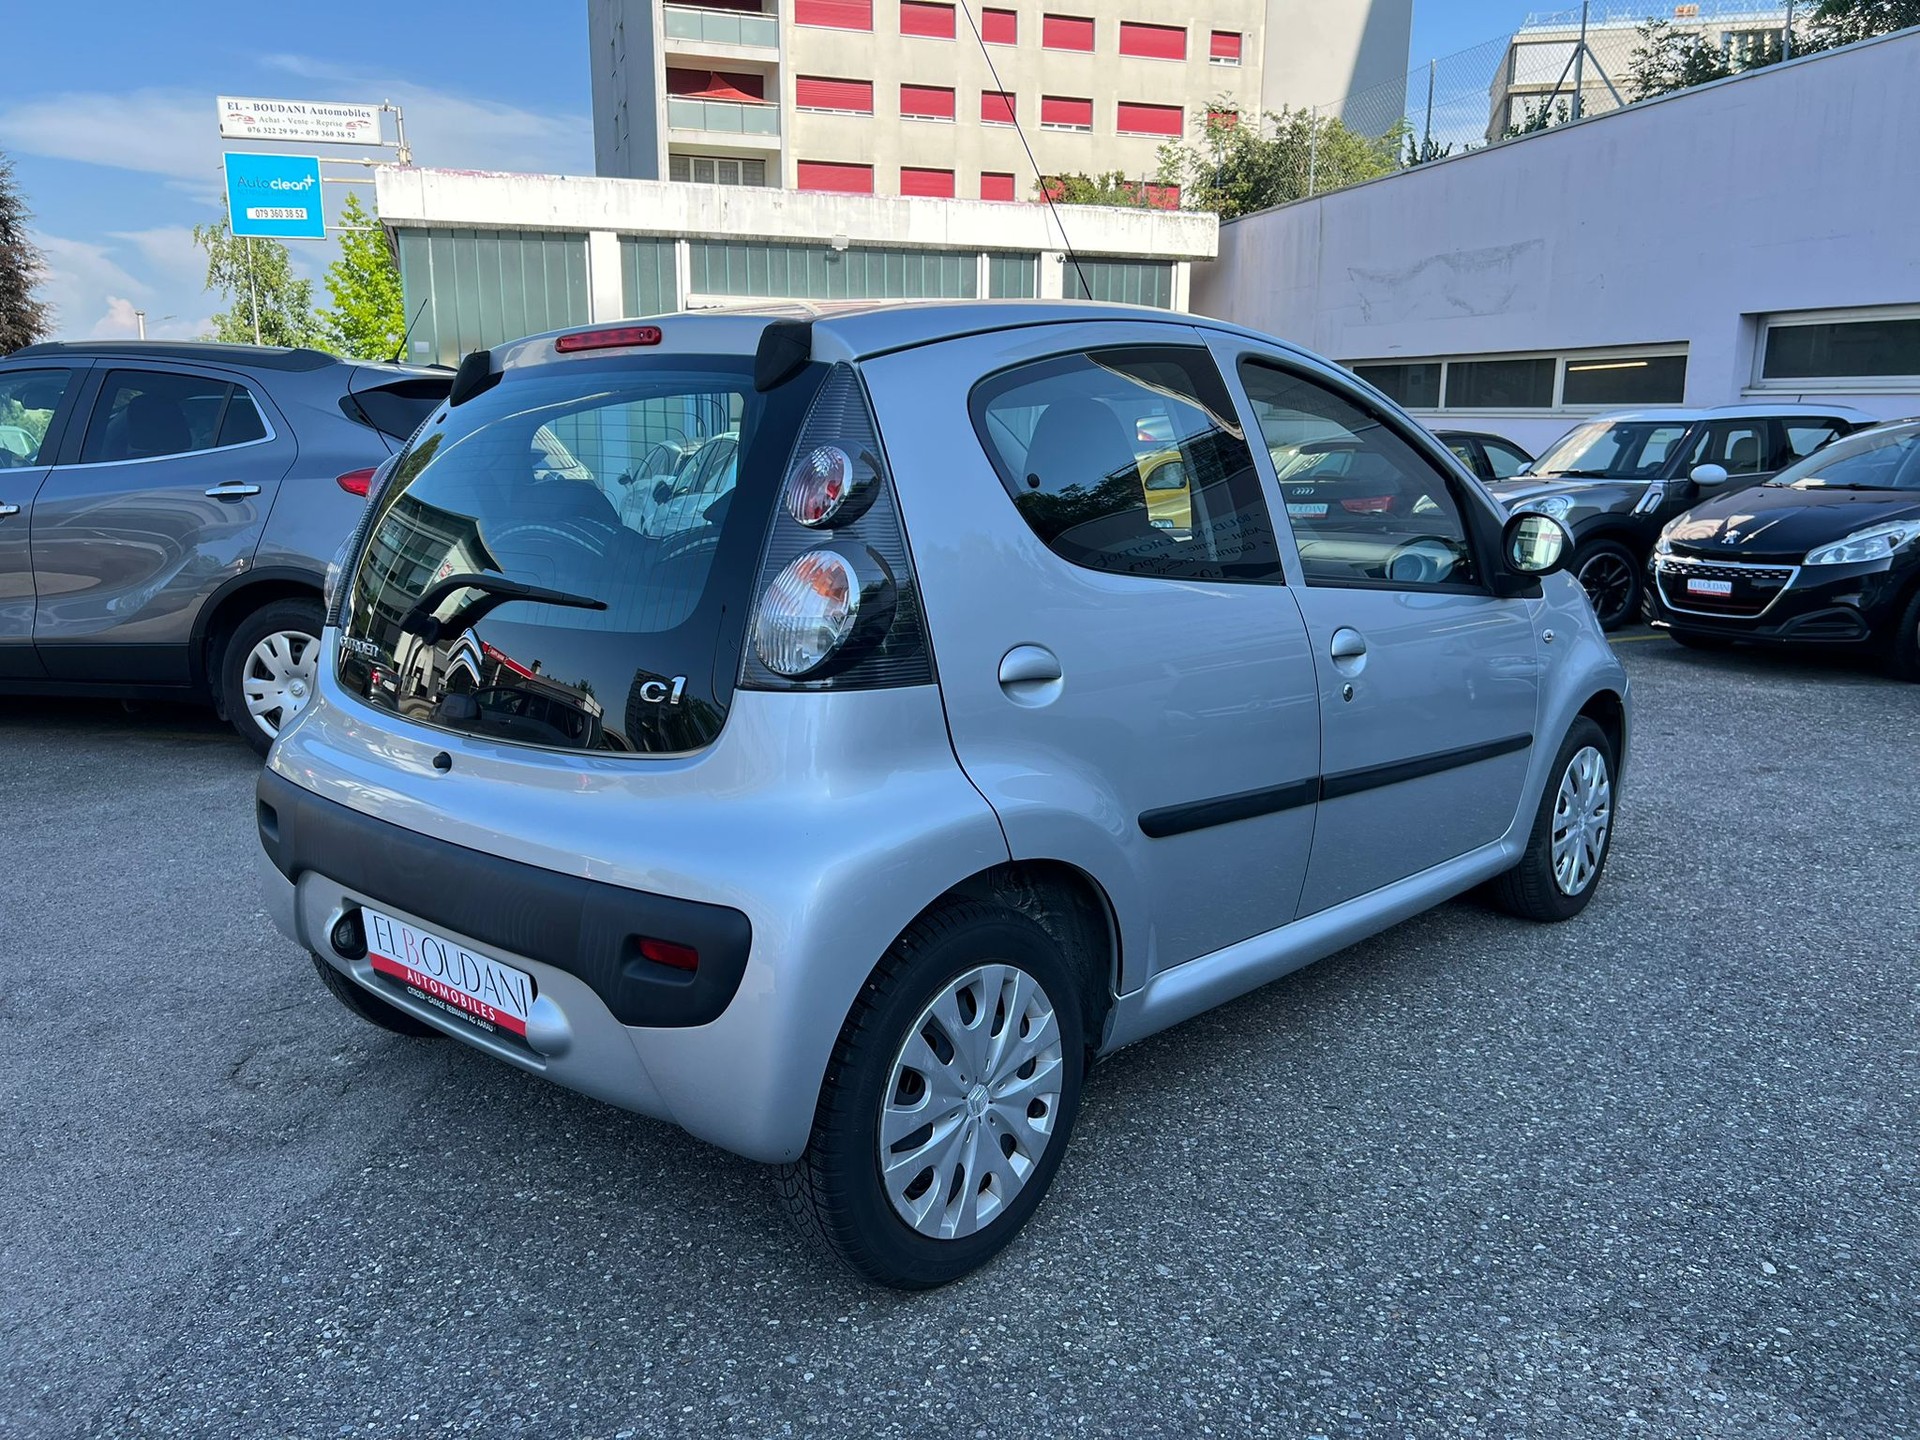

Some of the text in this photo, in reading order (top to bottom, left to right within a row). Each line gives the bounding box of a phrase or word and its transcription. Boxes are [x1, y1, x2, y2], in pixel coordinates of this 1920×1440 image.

[227, 102, 242, 110] EL
[253, 103, 306, 114] BOUDANI
[310, 107, 371, 118] Automobiles
[255, 209, 269, 218] 079
[340, 635, 379, 657] CITROËN
[373, 915, 528, 1018] EL BOUDANI
[407, 969, 496, 1021] AUTOMOBILES
